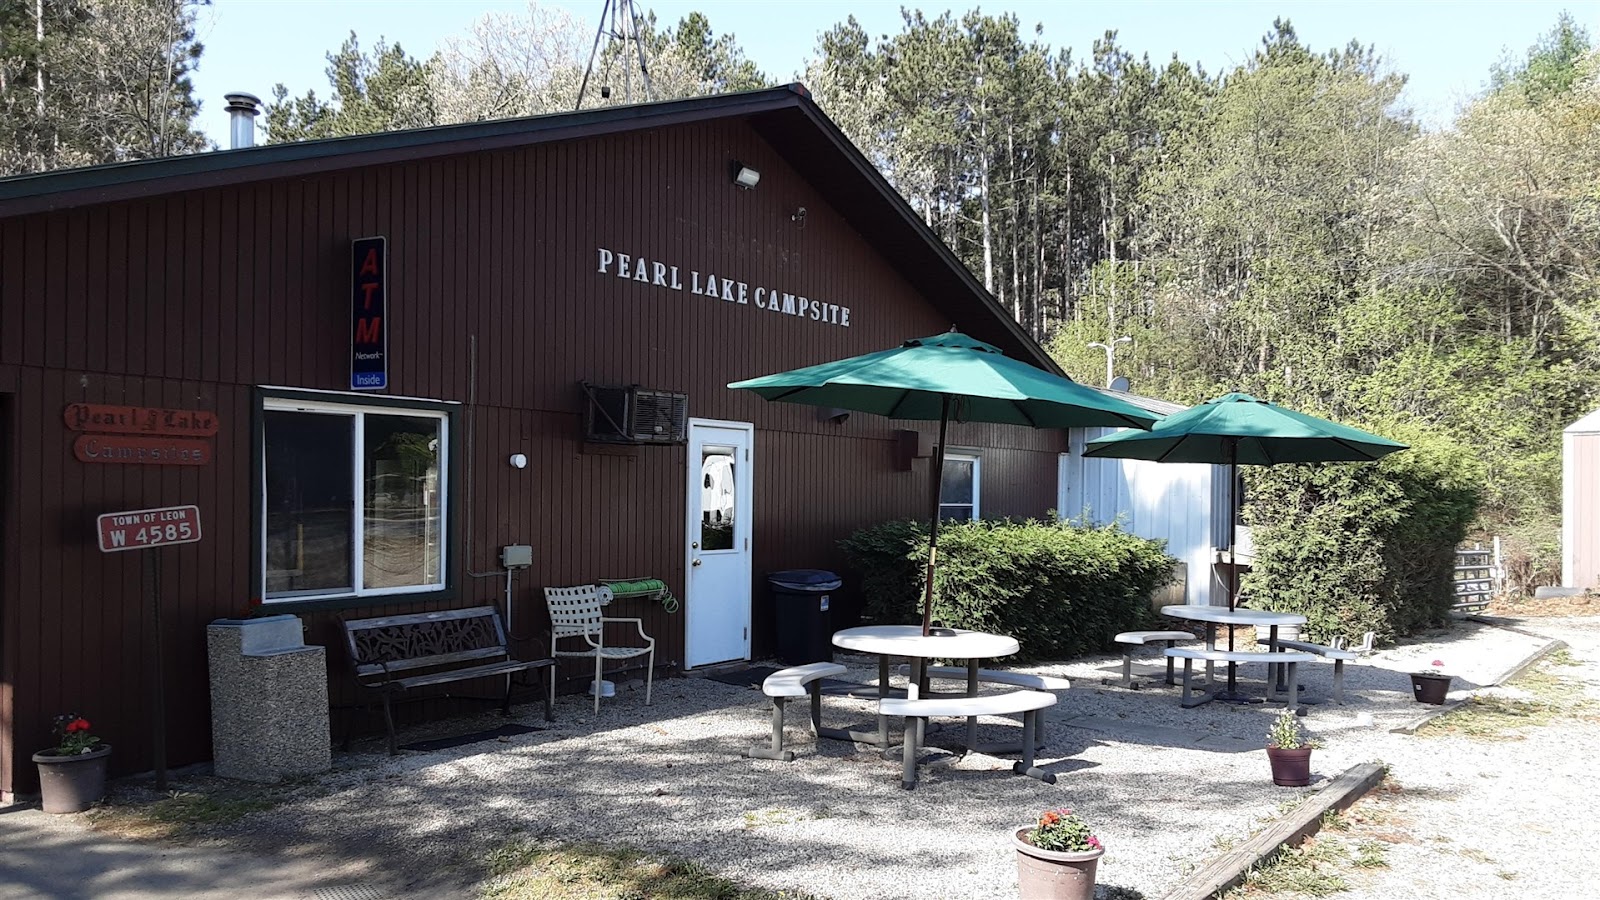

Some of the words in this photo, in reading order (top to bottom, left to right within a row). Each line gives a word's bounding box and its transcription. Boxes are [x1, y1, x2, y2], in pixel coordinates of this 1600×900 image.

[356, 248, 381, 343] ATM
[598, 248, 682, 290] PEARL
[691, 271, 748, 305] LAKE
[754, 286, 850, 328] CAMPSITE
[356, 374, 380, 385] Inside
[72, 404, 137, 427] Pearl
[163, 410, 211, 430] Lake
[85, 440, 202, 462] Campsites
[112, 515, 140, 527] TOWN
[143, 513, 156, 523] OF
[160, 510, 186, 521] LEON
[110, 530, 126, 547] W
[135, 522, 192, 545] 4585
